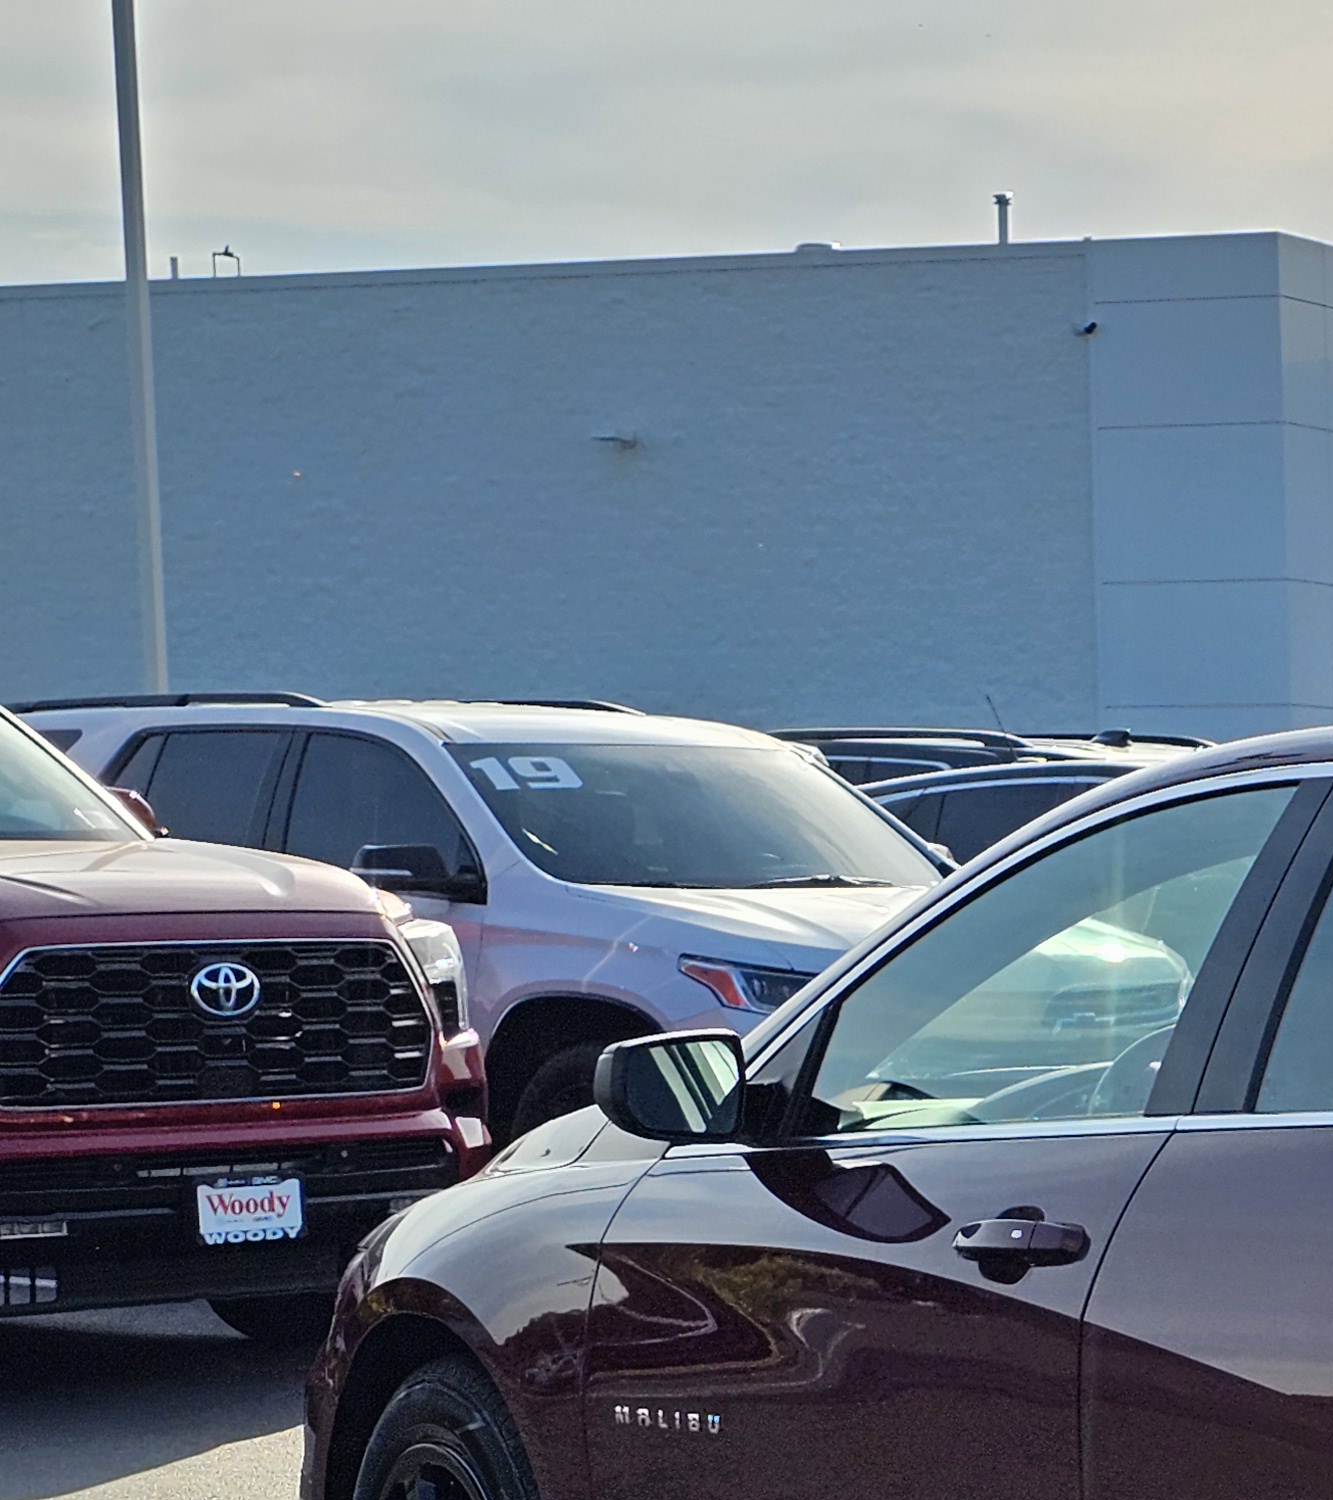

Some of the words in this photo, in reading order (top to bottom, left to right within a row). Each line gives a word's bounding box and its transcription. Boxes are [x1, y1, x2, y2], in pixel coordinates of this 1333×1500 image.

[469, 756, 583, 790] 19
[205, 1188, 291, 1219] Woody
[203, 1225, 299, 1246] WOODY
[614, 1405, 721, 1434] MALIBU
